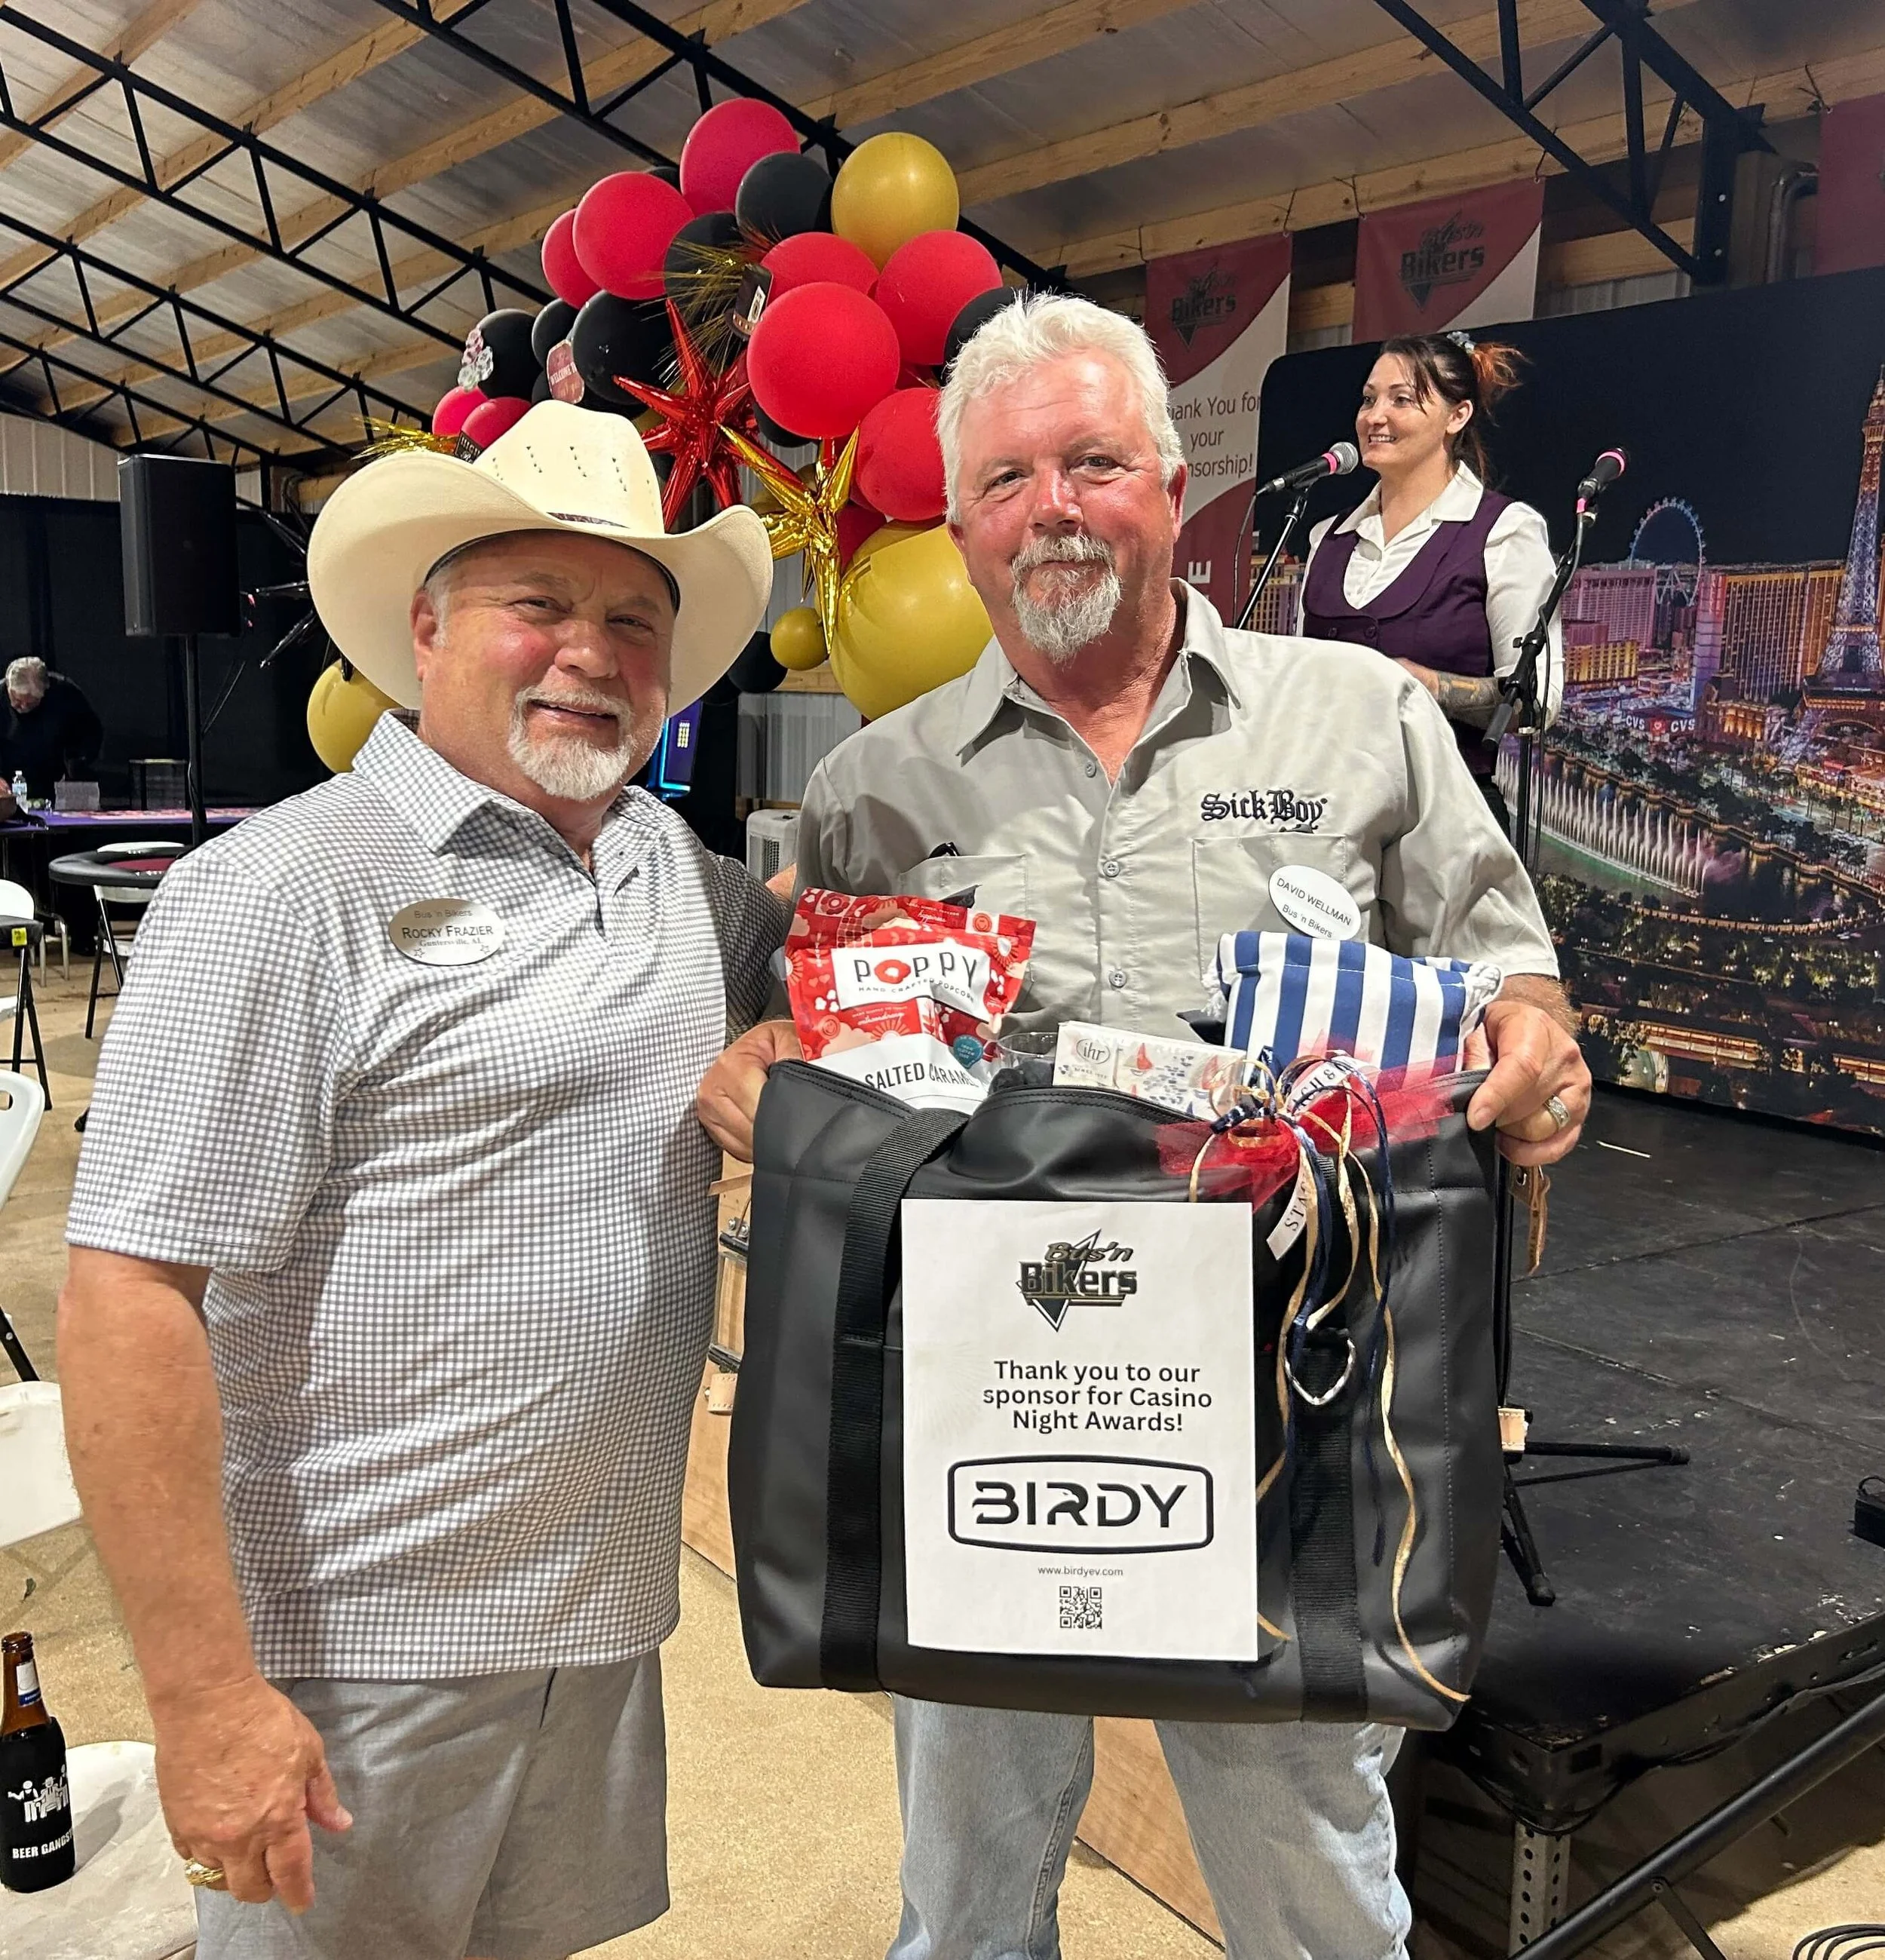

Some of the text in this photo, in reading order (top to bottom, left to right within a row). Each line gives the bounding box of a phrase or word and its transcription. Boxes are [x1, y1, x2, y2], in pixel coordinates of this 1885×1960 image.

[1400, 244, 1485, 281] Bikers
[1171, 397, 1202, 420] ank
[1207, 396, 1236, 416] You
[1190, 430, 1224, 452] your
[1187, 452, 1253, 478] nsorship!
[1626, 715, 1645, 731] CVS
[1670, 719, 1696, 733] CVS
[1277, 877, 1352, 926] DAVID WELLMAN
[415, 910, 434, 919] Bus
[446, 909, 473, 918] Bikers
[1282, 903, 1298, 919] Bus
[1308, 918, 1332, 938] Bikers
[401, 925, 495, 940] ROCKY FRAZIER
[854, 951, 978, 989] POPPY
[1083, 1042, 1105, 1061] ihr
[865, 1062, 925, 1090] SALTED
[1044, 1241, 1134, 1262] Bus'n
[1018, 1261, 1138, 1296] Bikers
[994, 1360, 1200, 1385] Thank you to our
[982, 1386, 1212, 1409] sponsor for Casino
[1013, 1409, 1182, 1434] Night Awards!
[972, 1480, 1188, 1528] BIRDY
[1038, 1565, 1123, 1578] www.birdyev.com
[12, 1846, 38, 1859] BEER
